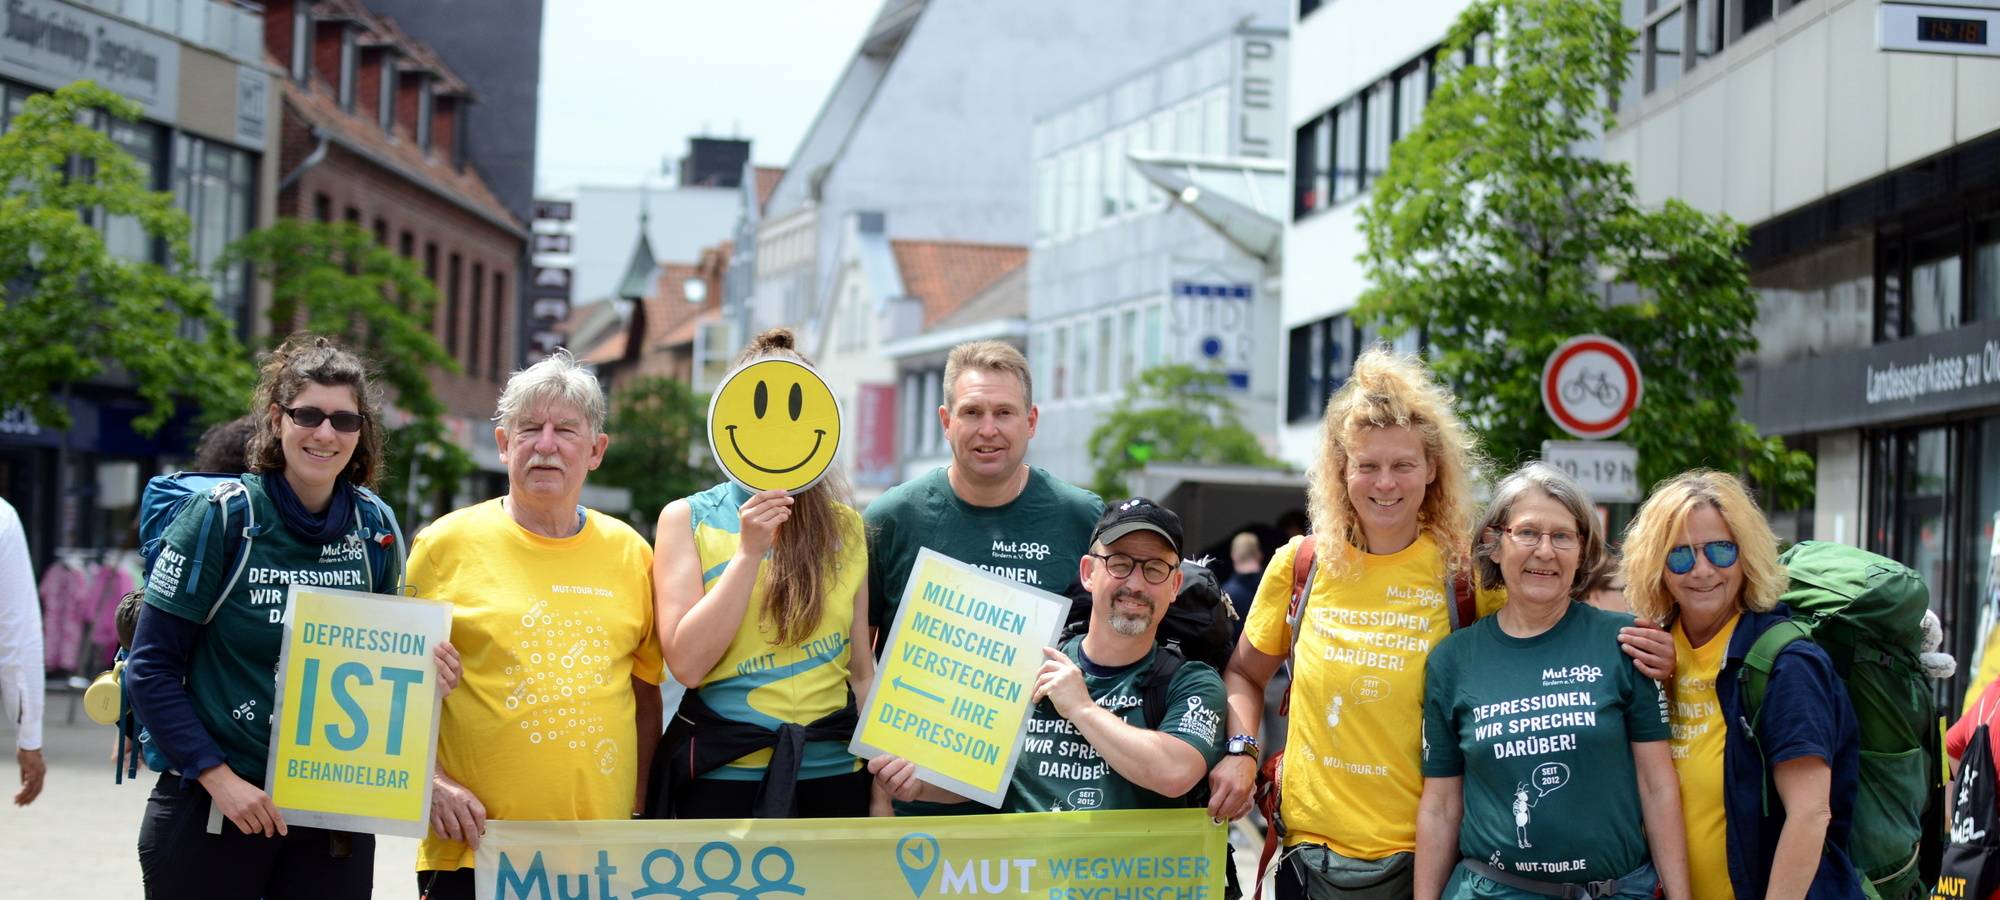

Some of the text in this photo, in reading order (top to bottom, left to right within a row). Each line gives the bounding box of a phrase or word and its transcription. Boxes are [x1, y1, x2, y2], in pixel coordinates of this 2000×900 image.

[1241, 41, 1273, 158] PEL
[1866, 340, 2000, 404] Landessparkasse zu Ol
[321, 543, 341, 557] Mut
[991, 540, 1017, 553] Mut
[248, 567, 366, 586] DEPRESSIONEN.
[249, 588, 282, 605] WIR
[551, 584, 593, 595] MUT-TOUR
[1387, 585, 1412, 599] Mut
[922, 581, 1026, 635] MILLIONEN
[303, 622, 426, 656] DEPRESSION
[911, 611, 1017, 666] MENSCHEN
[736, 632, 842, 676] MUT TOUR
[1323, 646, 1406, 672] DARÜBER!
[902, 641, 1022, 703] VERSTECKEN
[1541, 666, 1569, 680] Mut
[295, 657, 424, 756] IST
[950, 696, 999, 730] IHRE
[1199, 705, 1220, 724] MUT
[1472, 692, 1597, 723] DEPRESSIONEN.
[1183, 710, 1217, 733] ATLAS
[1475, 711, 1597, 742] WIR SPRECHEN
[878, 703, 1000, 766] DEPRESSION
[1025, 738, 1053, 755] WIR
[1493, 733, 1577, 760] DARÜBER!
[287, 759, 409, 790] BEHANDELBAR
[1038, 760, 1110, 781] DARÜBER!
[1541, 765, 1558, 776] SEIT
[1541, 776, 1560, 786] 2012
[1077, 798, 1096, 806] 2012
[495, 850, 618, 900] Mut
[939, 856, 1211, 895] MUT WEGWEISER
[1515, 859, 1587, 873] MUT-TOUR.DE
[1048, 885, 1210, 900] PSYCHISCHE
[1937, 875, 1967, 898] MUT
